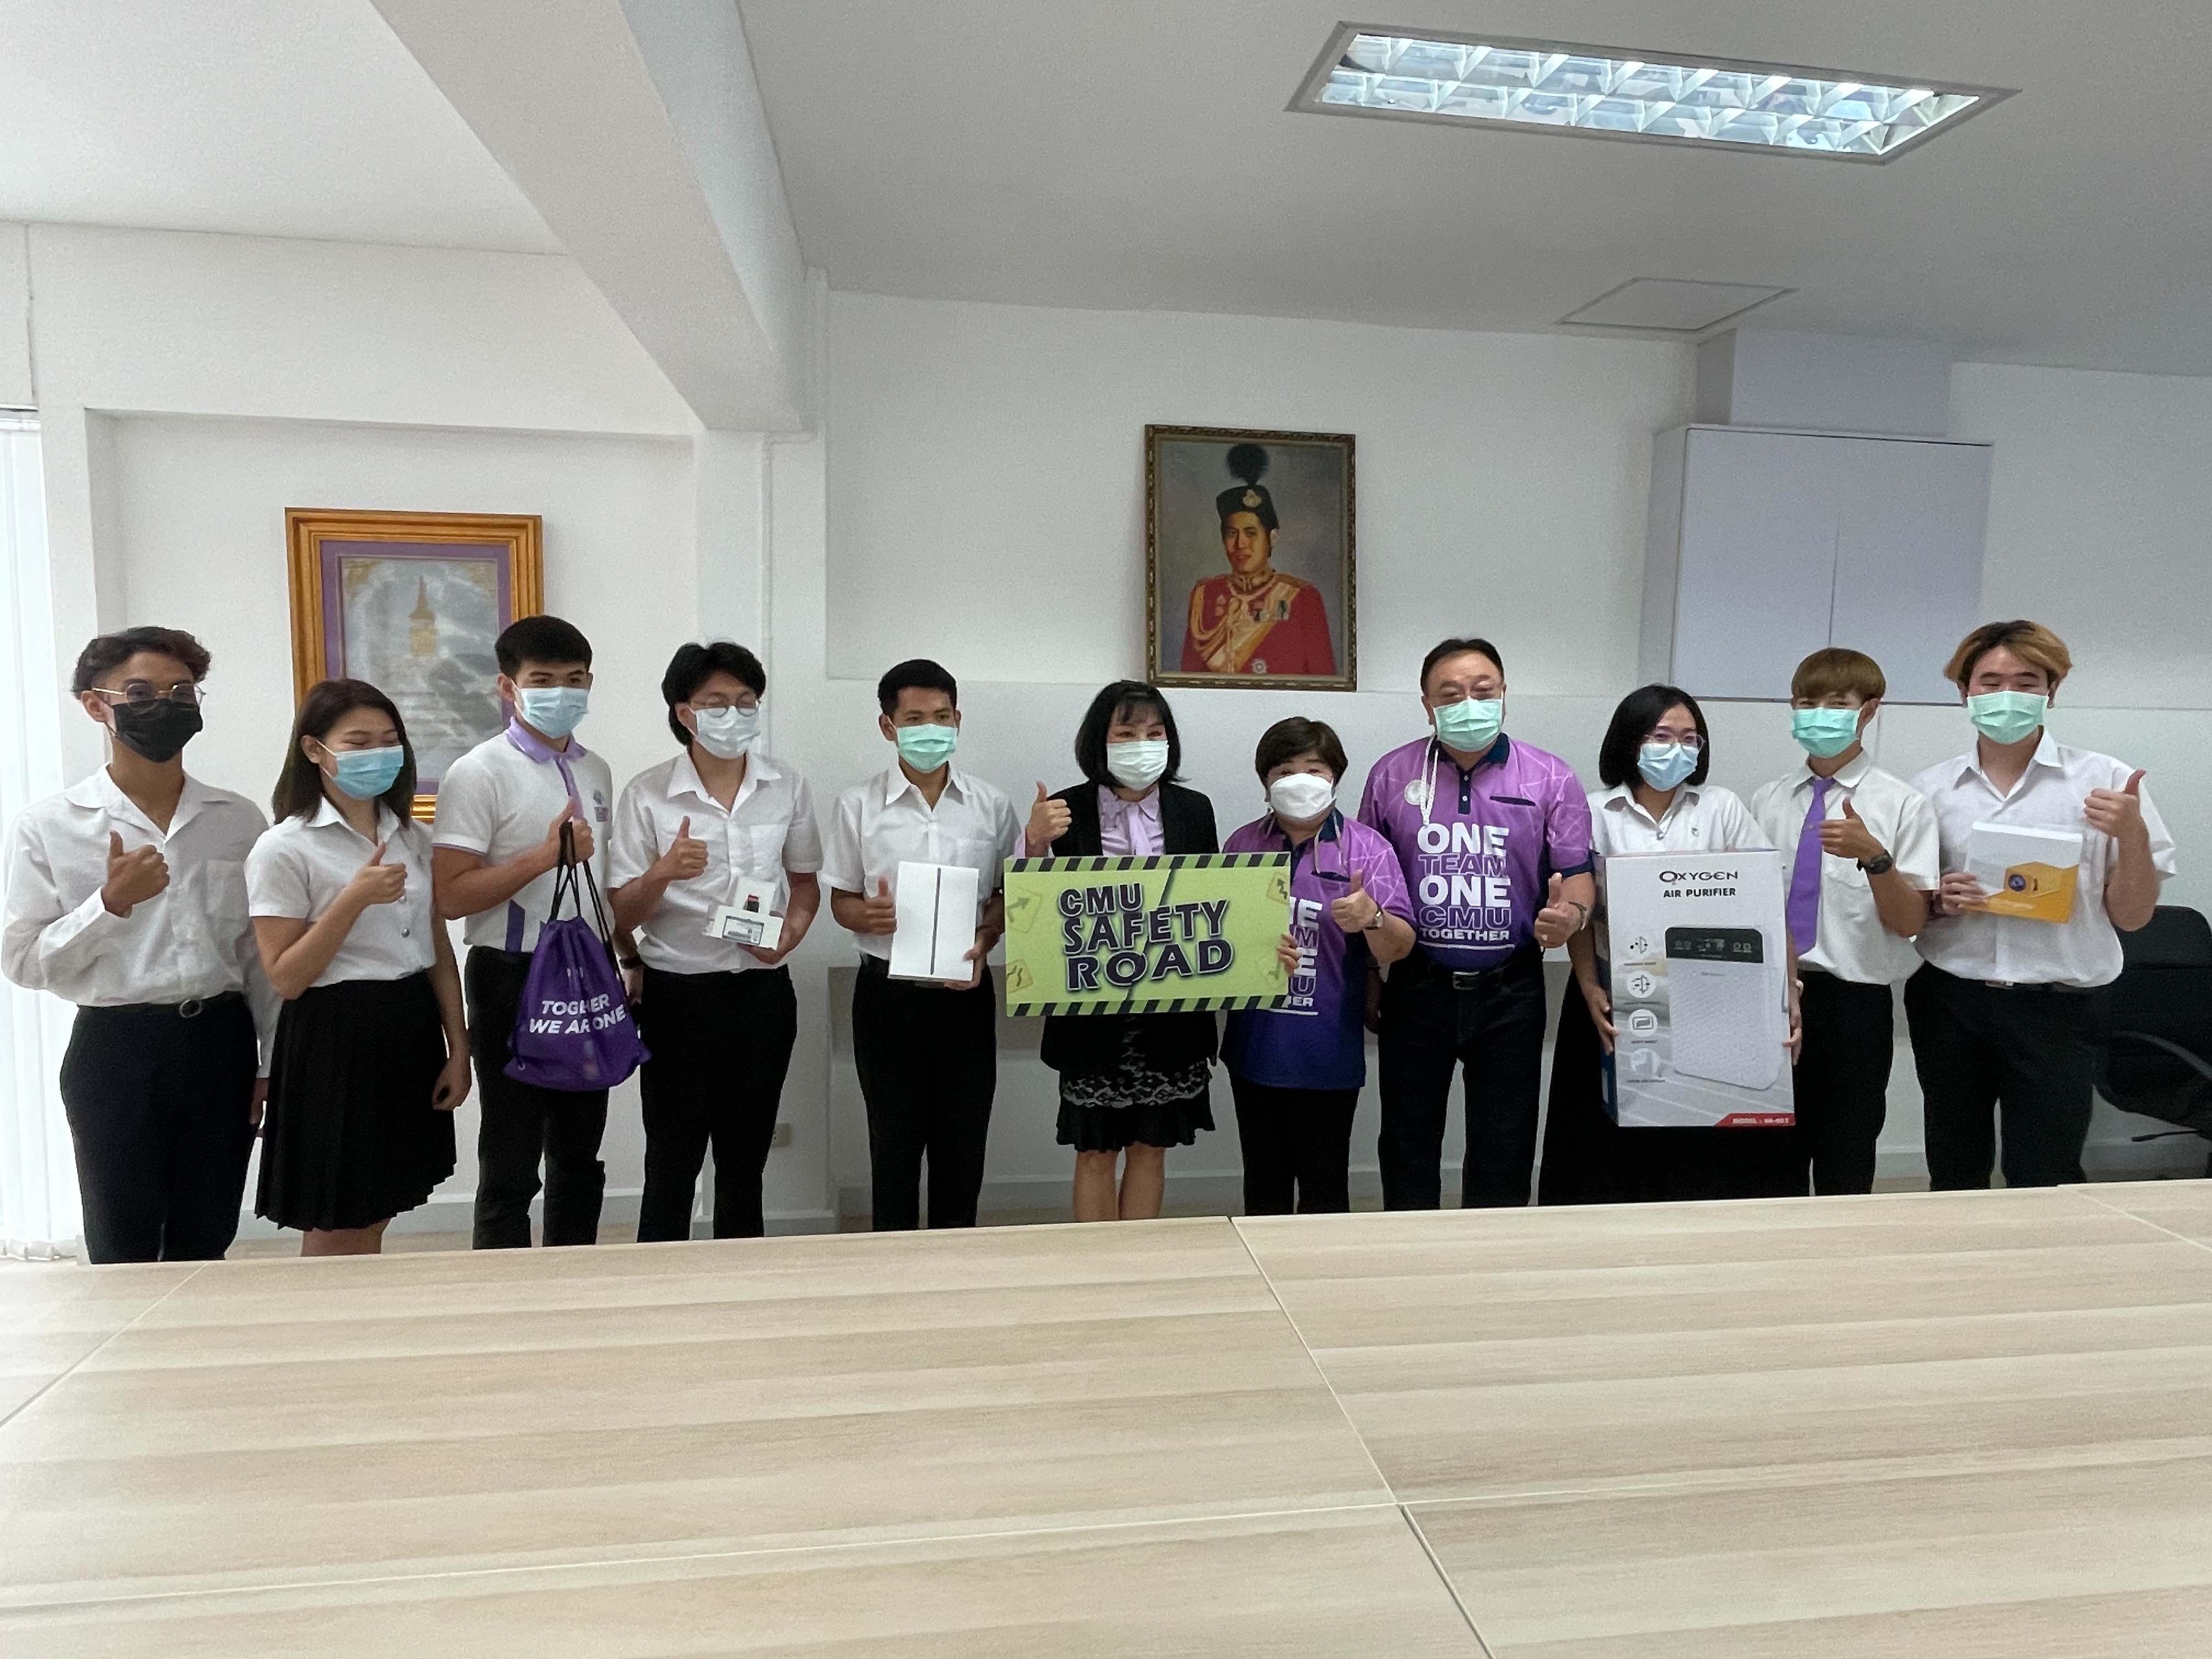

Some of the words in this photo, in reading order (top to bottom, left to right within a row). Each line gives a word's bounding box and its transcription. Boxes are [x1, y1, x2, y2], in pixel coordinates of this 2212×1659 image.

[1418, 822, 1509, 857] ONE
[1418, 853, 1506, 877] TEAM
[1659, 871, 1738, 883] OXYGEN
[1059, 882, 1143, 917] CMU
[1419, 874, 1511, 907] ONE
[1663, 889, 1681, 898] AIR
[1686, 888, 1736, 898] PURIFIER
[1063, 900, 1229, 955] SAFETY
[1419, 905, 1512, 930] CMU
[1420, 927, 1509, 941] TOGETHER
[1067, 939, 1233, 991] ROAD
[541, 993, 610, 1015] TOGER
[529, 1018, 563, 1034] WE
[565, 1019, 590, 1035] AR
[592, 1004, 626, 1030] ONE
